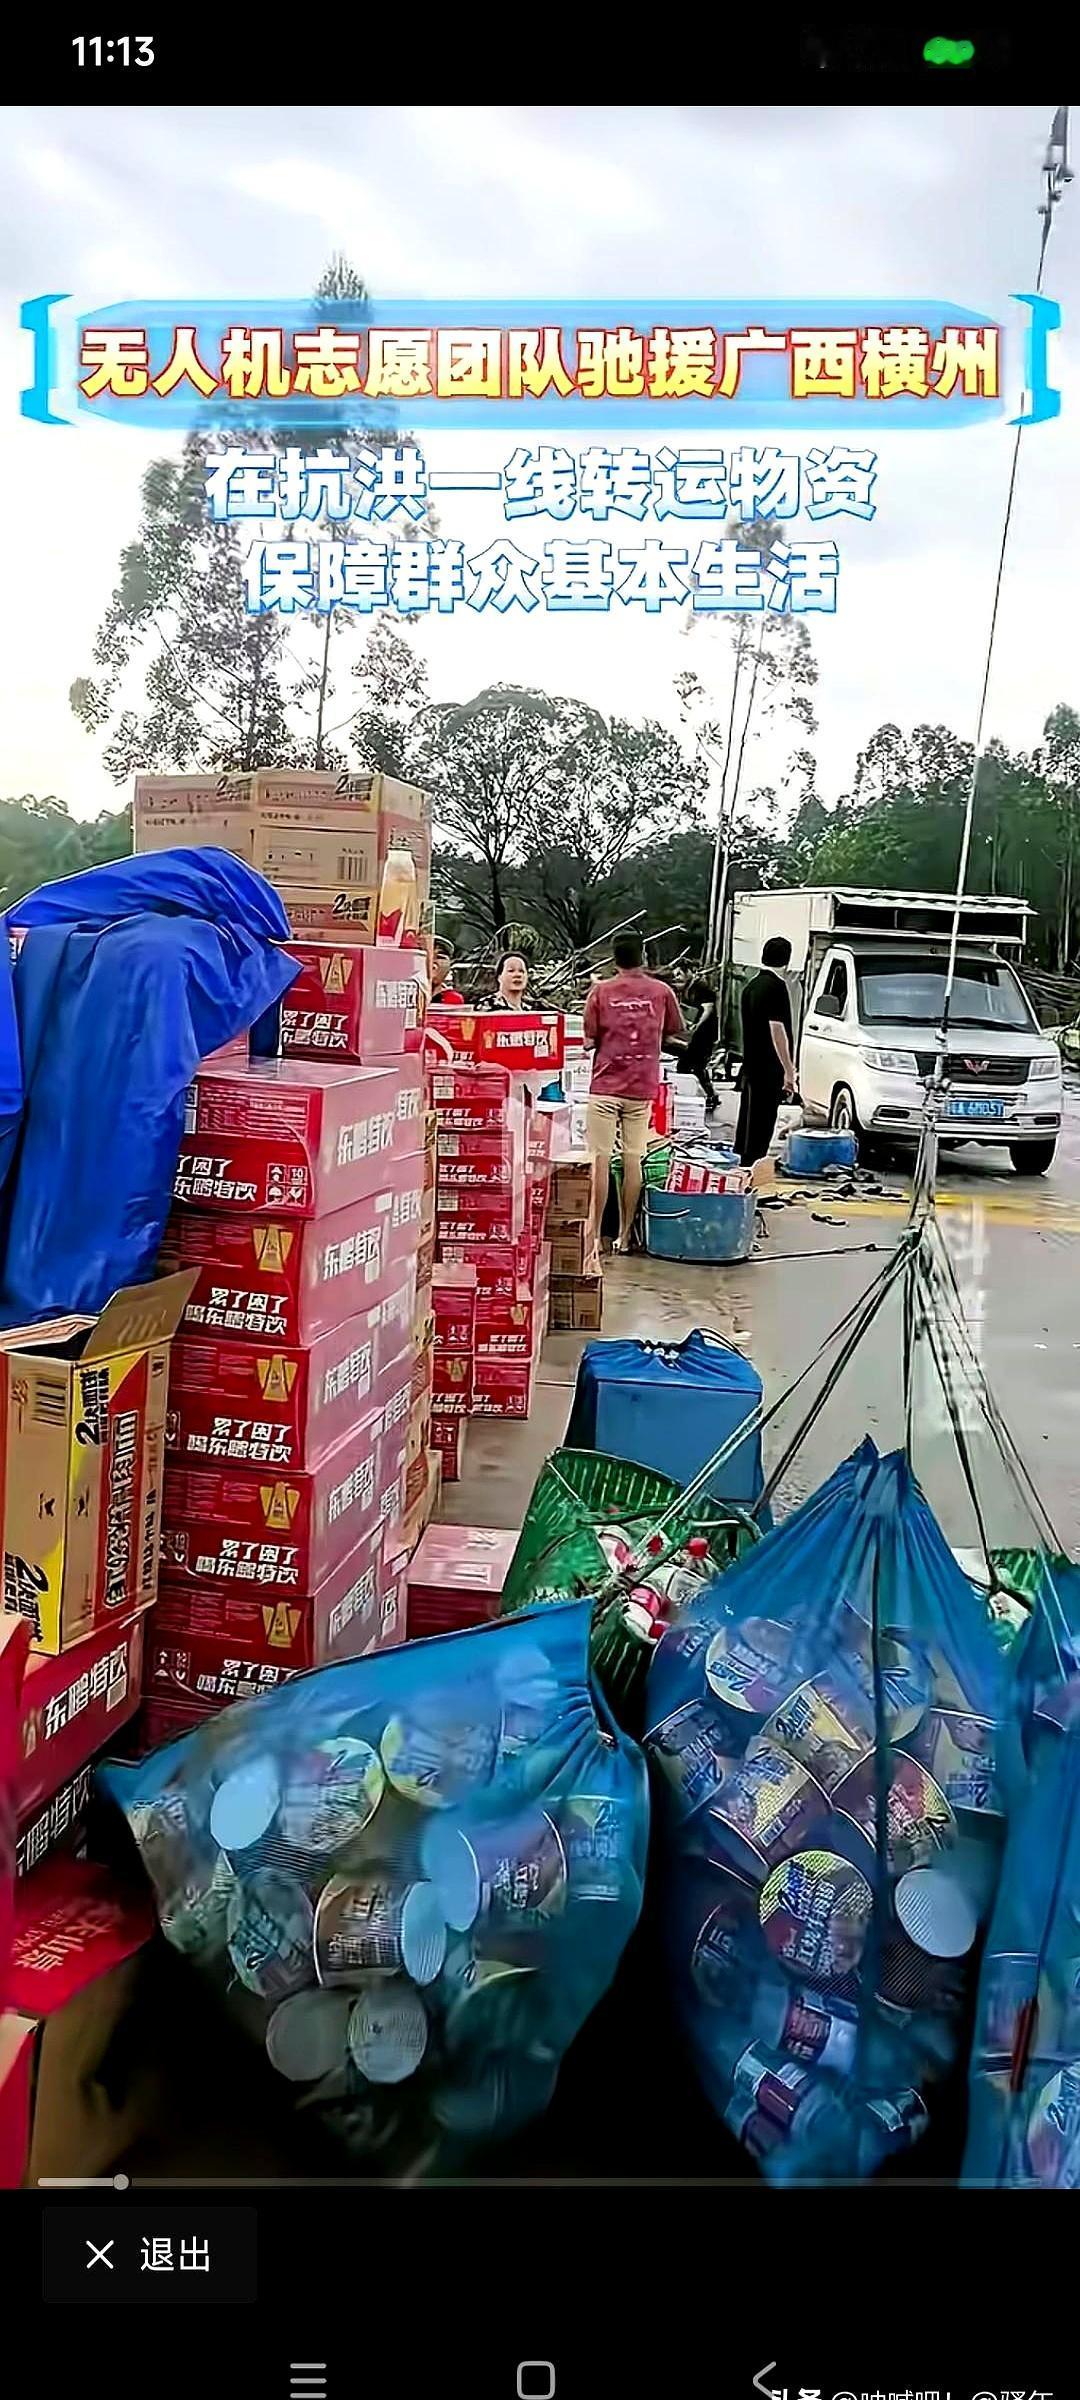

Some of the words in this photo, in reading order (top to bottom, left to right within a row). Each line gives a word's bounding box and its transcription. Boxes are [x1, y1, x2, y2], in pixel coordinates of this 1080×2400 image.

[72, 37, 154, 66] 11:13
[173, 1175, 258, 1202] 东鹏特饮
[209, 1287, 288, 1315] 累了困了
[212, 1417, 292, 1443] 累了困了
[220, 1539, 299, 1565] 累了困了
[44, 1641, 128, 1741] 东鹏特饮
[141, 2236, 209, 2272] 退出
